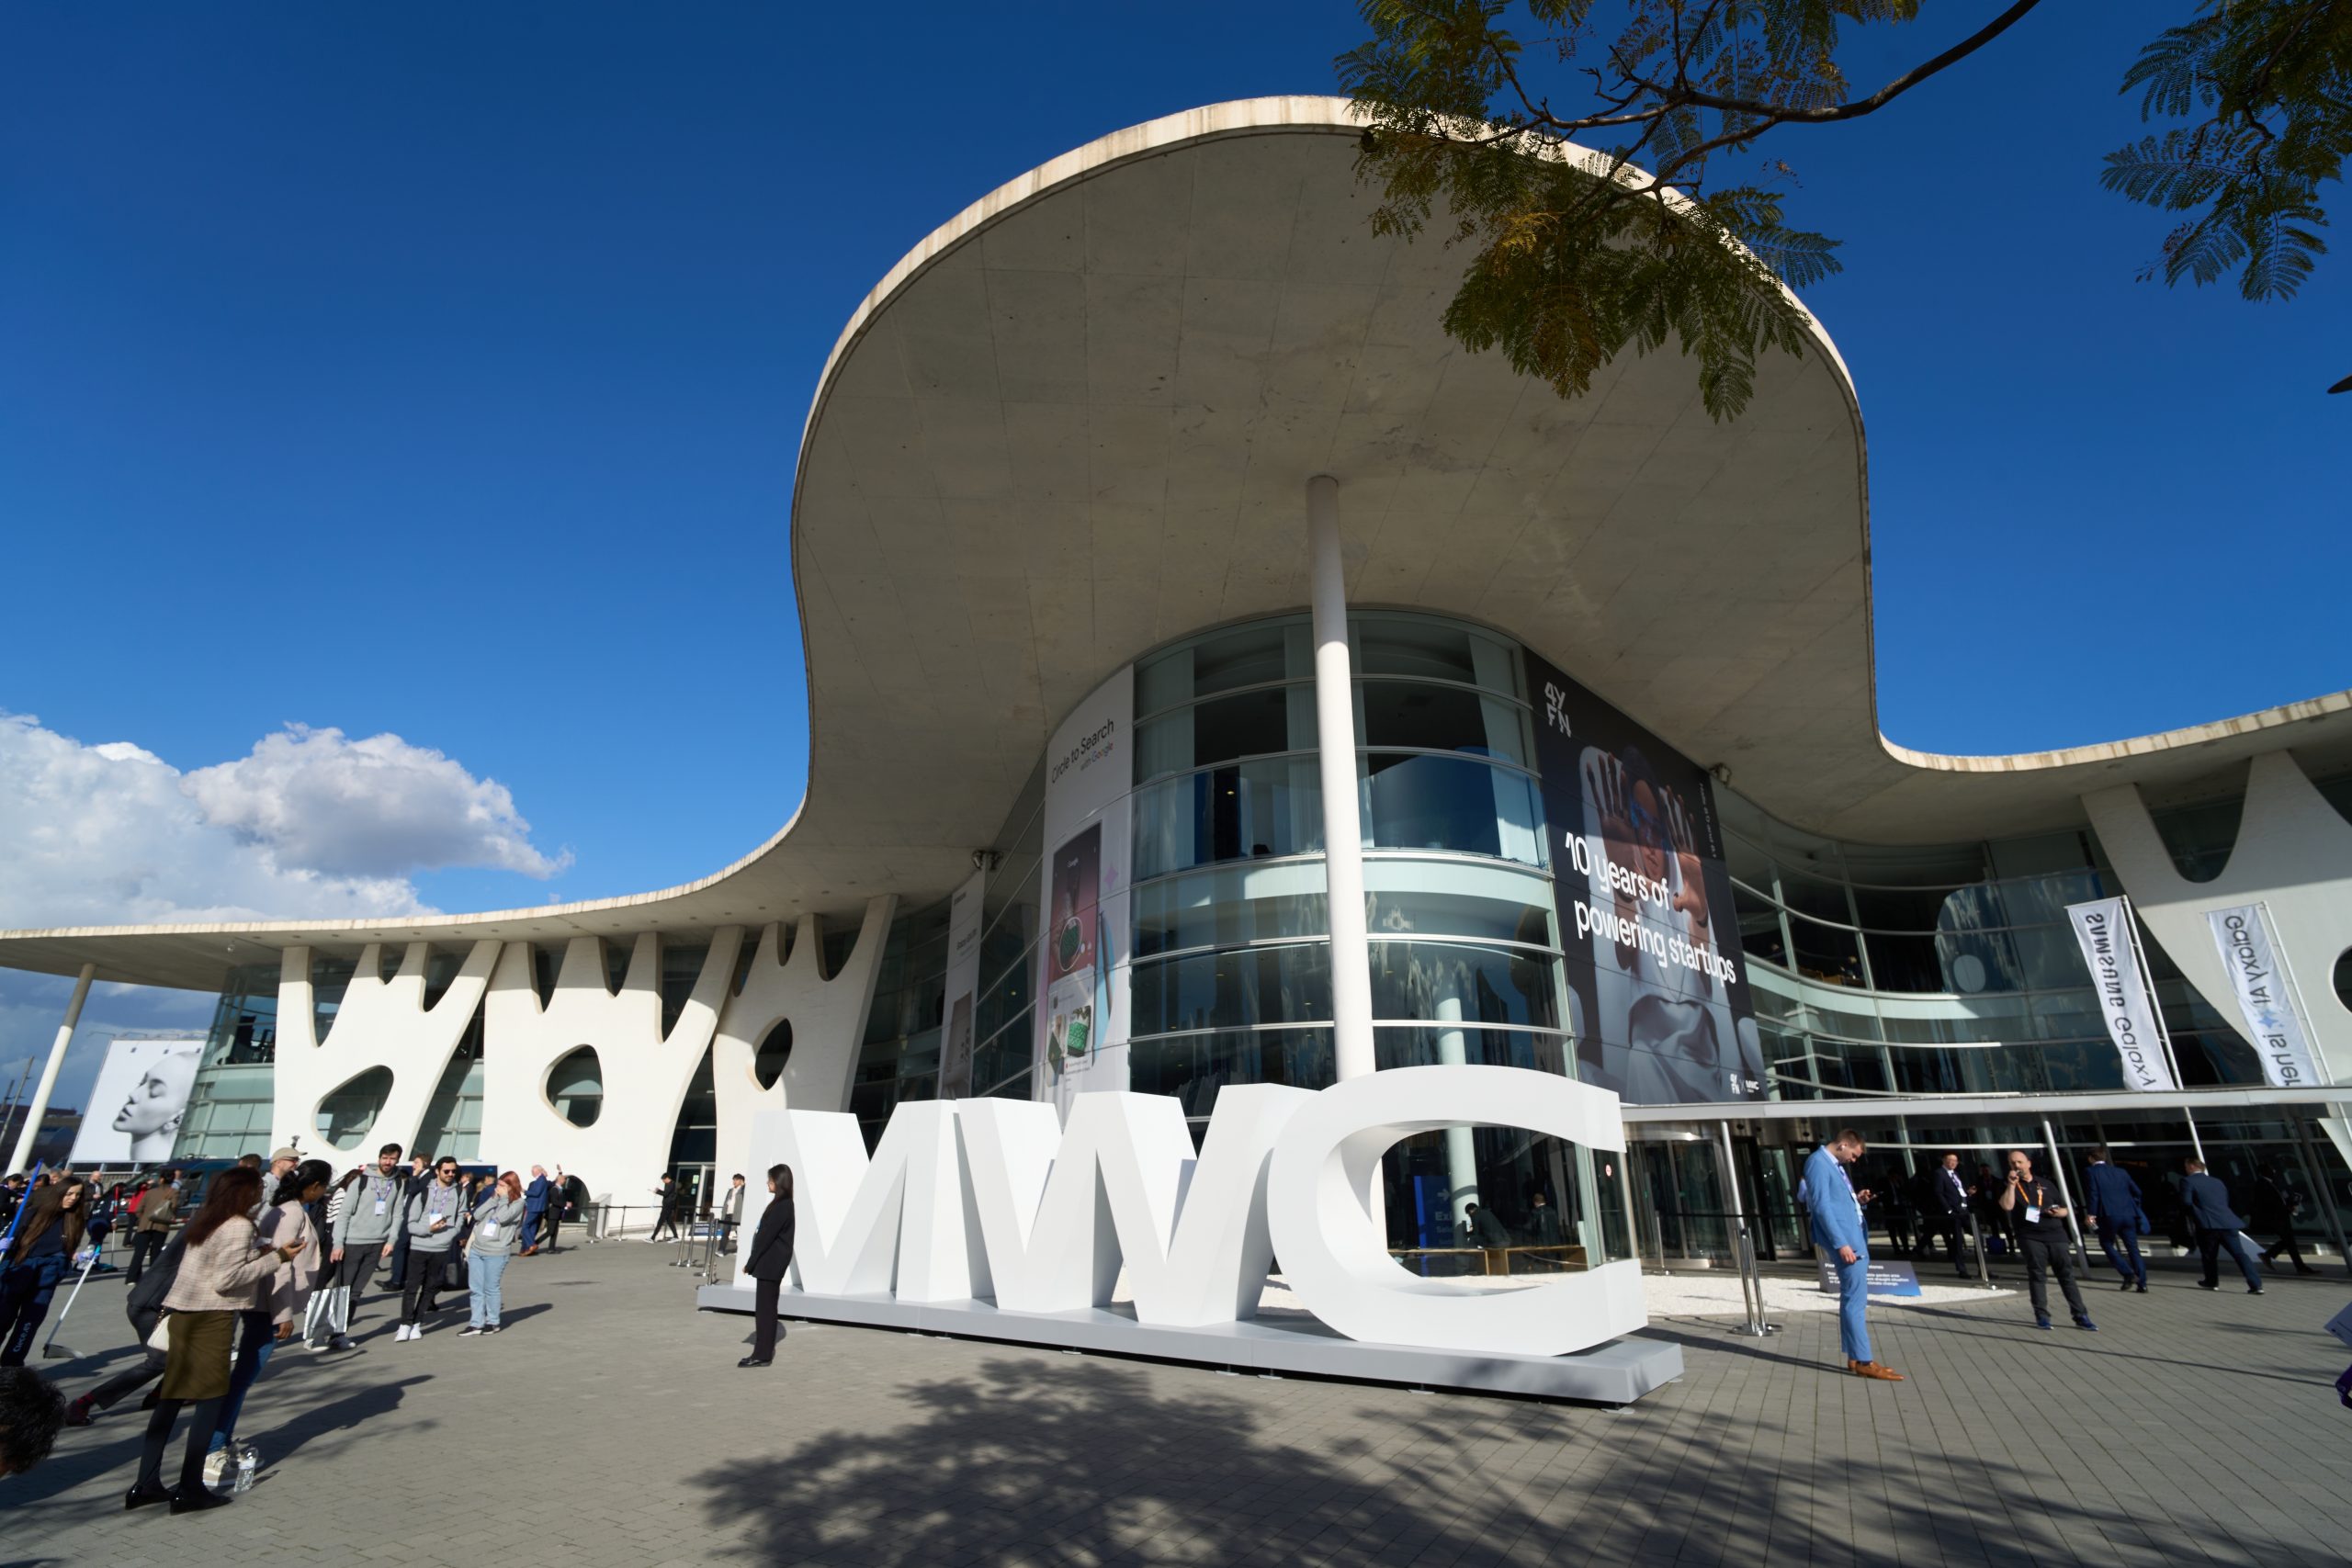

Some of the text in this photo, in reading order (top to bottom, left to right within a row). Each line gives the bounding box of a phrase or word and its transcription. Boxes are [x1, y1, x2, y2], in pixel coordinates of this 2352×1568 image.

[1544, 682, 1566, 710] 4Y
[1546, 702, 1572, 739] FN
[1051, 717, 1114, 784] Circle to Search
[1565, 832, 1670, 910] 10 years of
[1574, 899, 1737, 988] powering startups
[733, 1064, 1648, 1356] MWC
